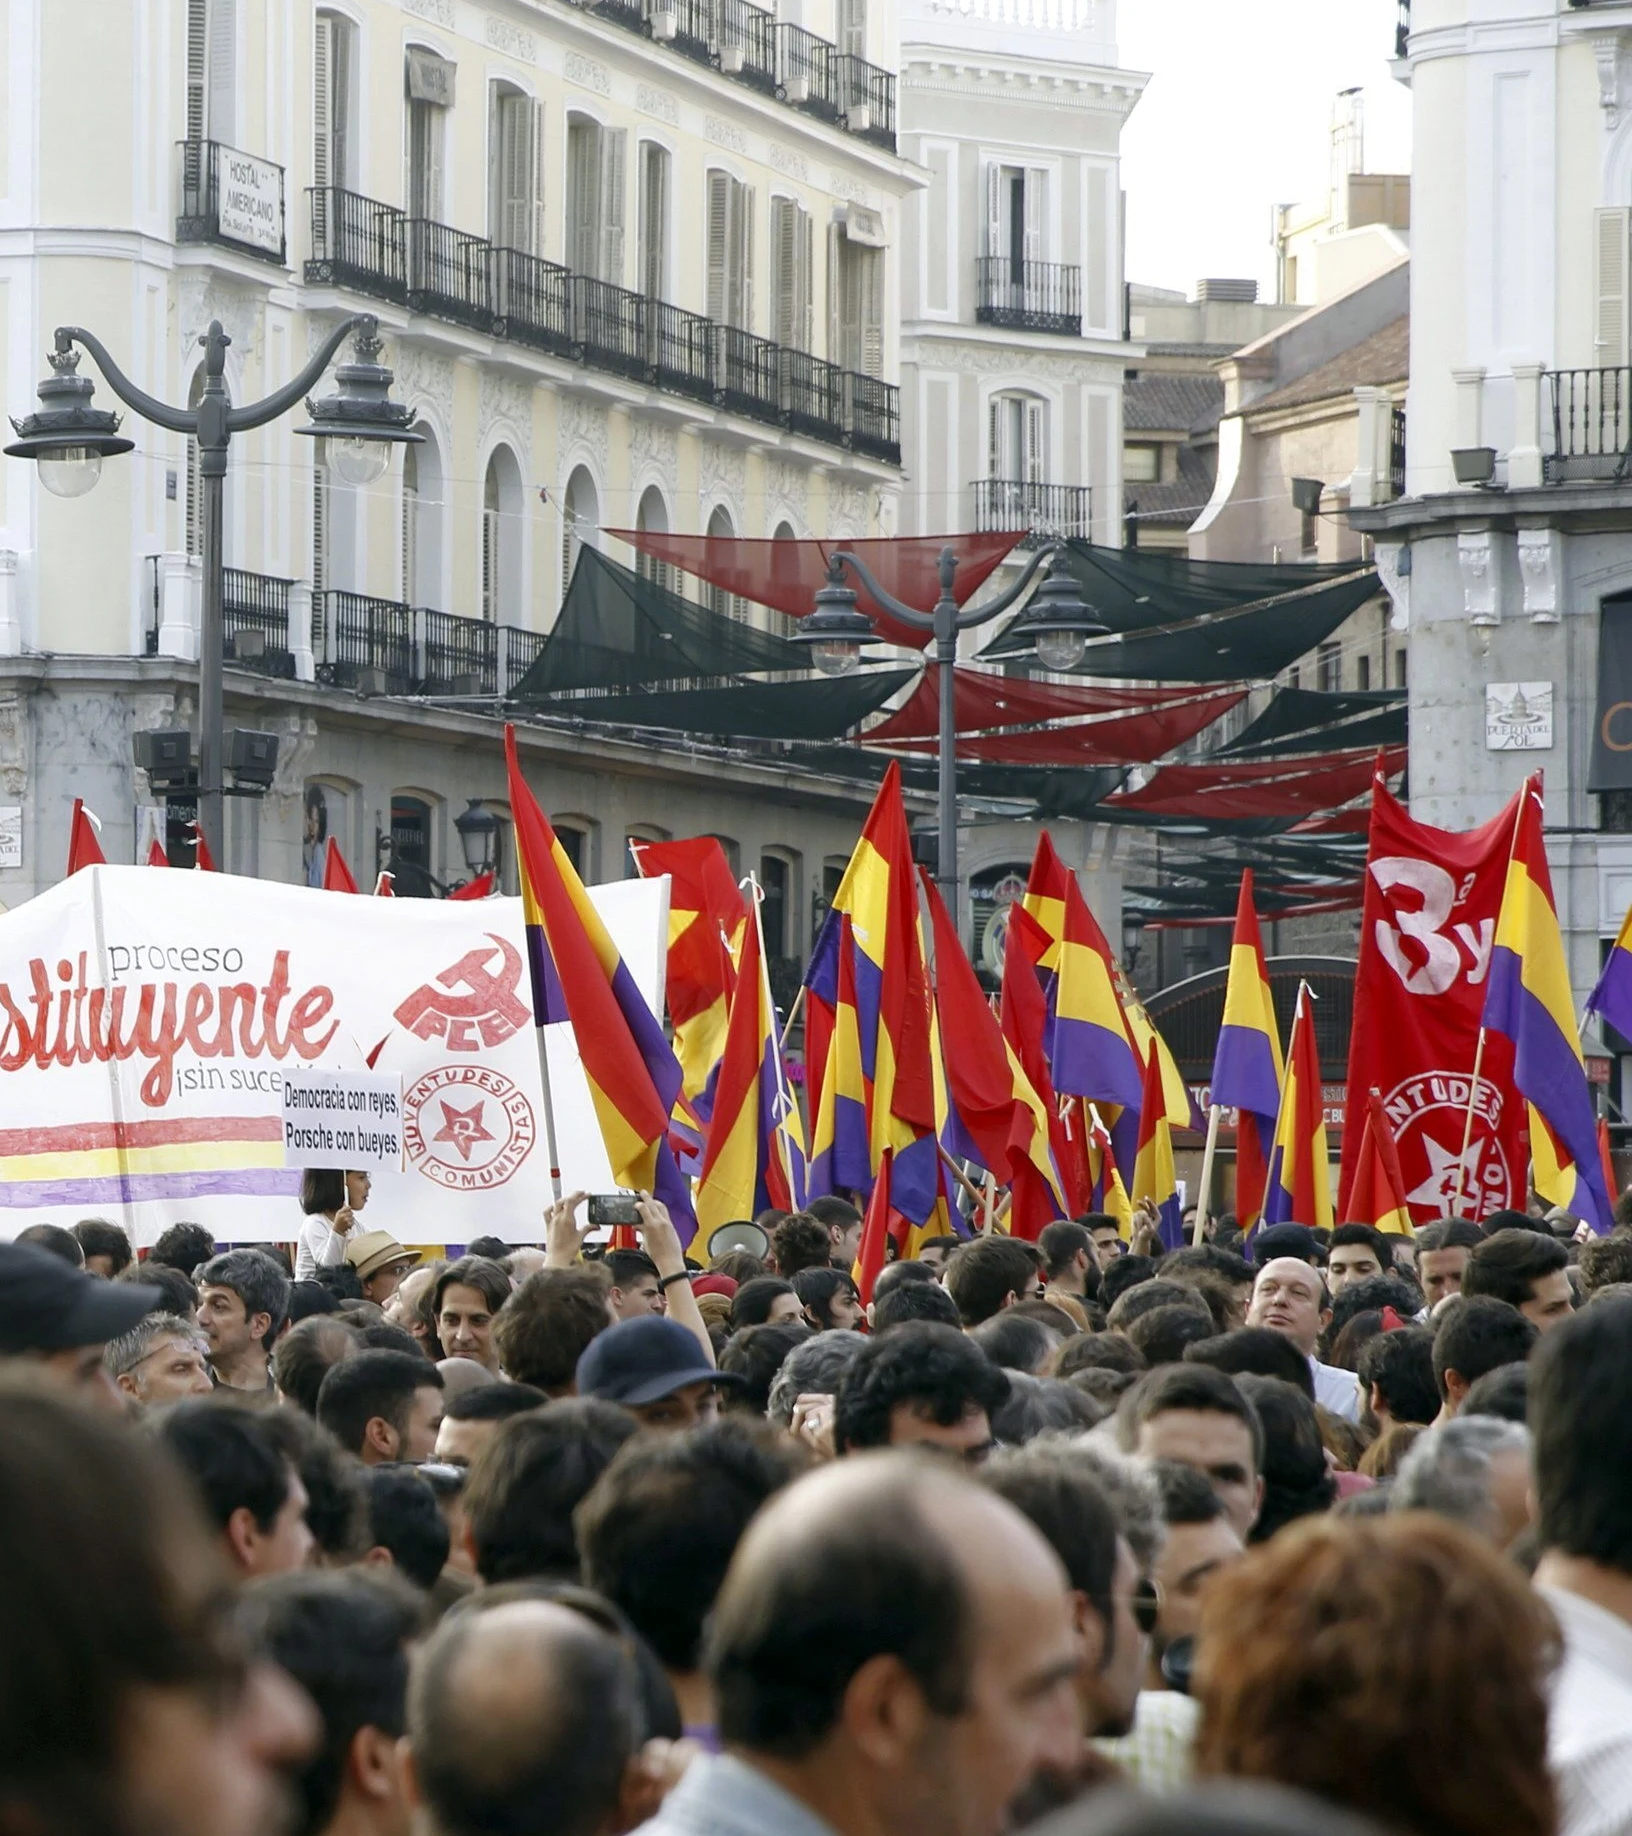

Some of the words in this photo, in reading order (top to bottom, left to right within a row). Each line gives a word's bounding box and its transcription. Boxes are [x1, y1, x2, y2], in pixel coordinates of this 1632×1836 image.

[229, 159, 261, 190] HOSTAL
[226, 188, 274, 223] AMERICANO
[109, 944, 244, 981] proceso
[410, 1010, 518, 1052] PCE
[231, 1066, 281, 1093] suce
[285, 1081, 345, 1112] Democracia
[347, 1088, 366, 1112] con
[368, 1092, 400, 1120] reyes,
[404, 1068, 505, 1153] JUVENTUDES
[1384, 1078, 1501, 1128] NTUDES
[286, 1121, 333, 1151] Porsche
[336, 1130, 356, 1152] con
[359, 1125, 401, 1160] bueyes.
[429, 1100, 532, 1188] COMUNISTAS
